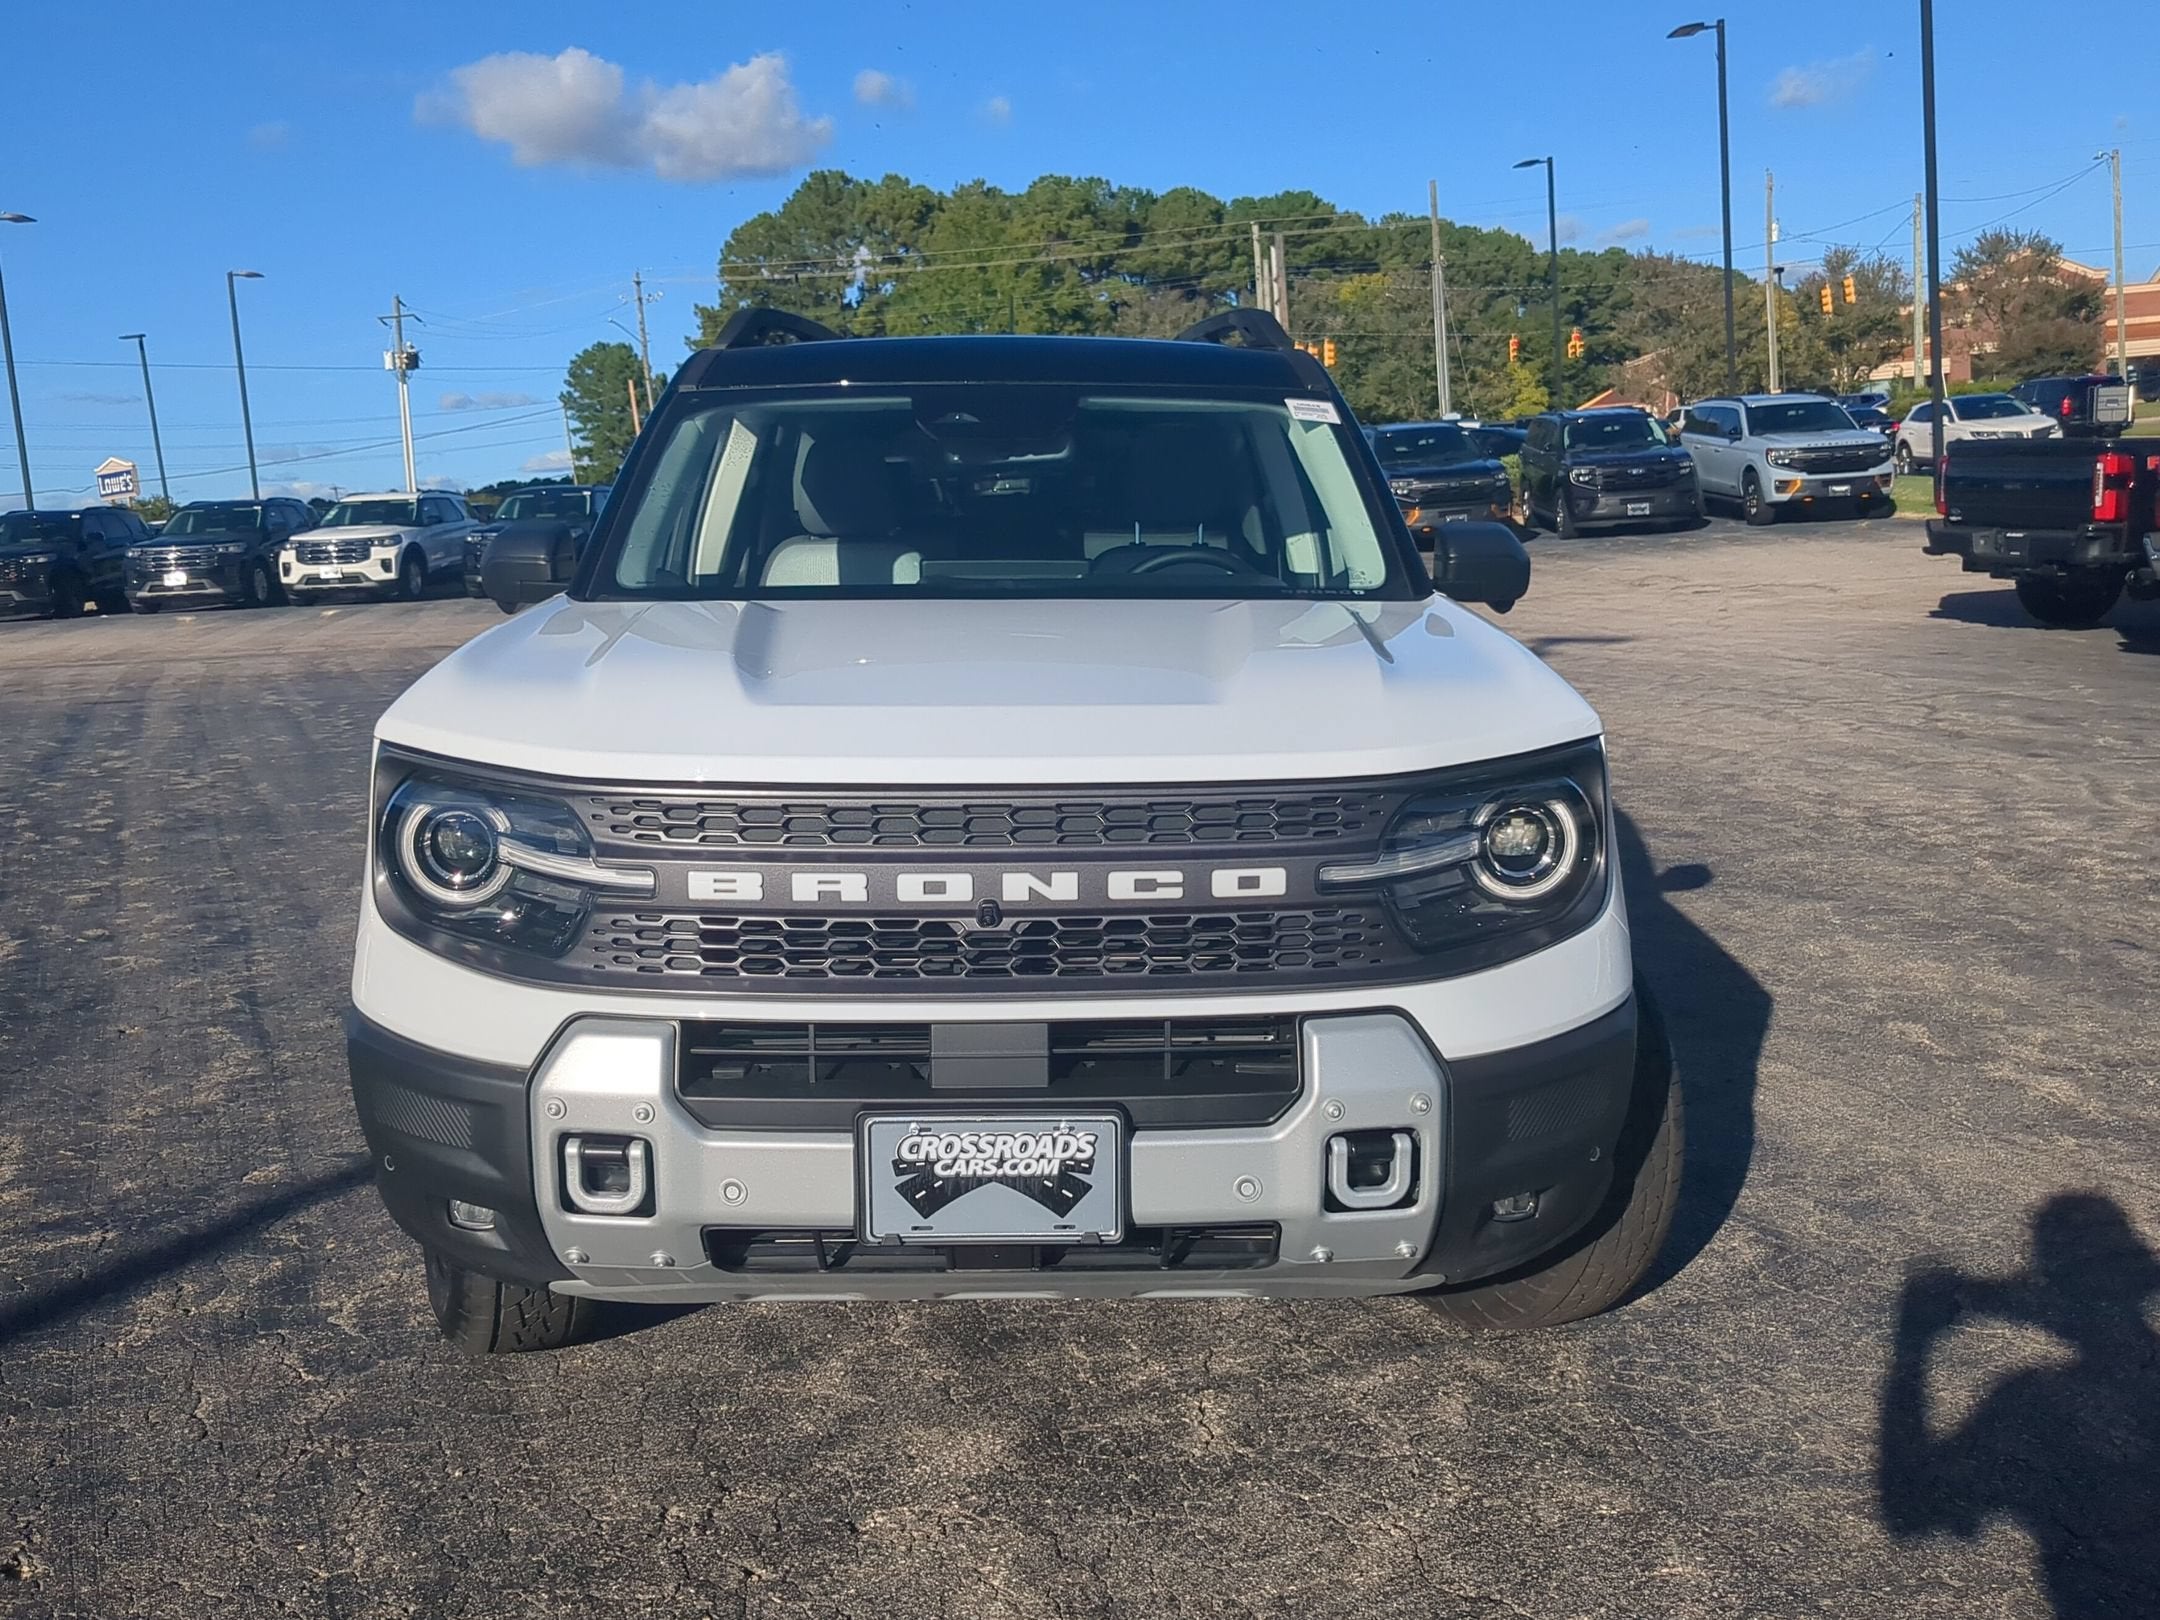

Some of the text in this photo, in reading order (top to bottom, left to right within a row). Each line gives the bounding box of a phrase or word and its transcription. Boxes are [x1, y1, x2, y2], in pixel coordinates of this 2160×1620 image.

[98, 472, 133, 495] LOWE'S
[687, 867, 1287, 901] BRONCO
[898, 1133, 1096, 1161] CROSSROADS
[933, 1158, 1062, 1177] CARS.COM
